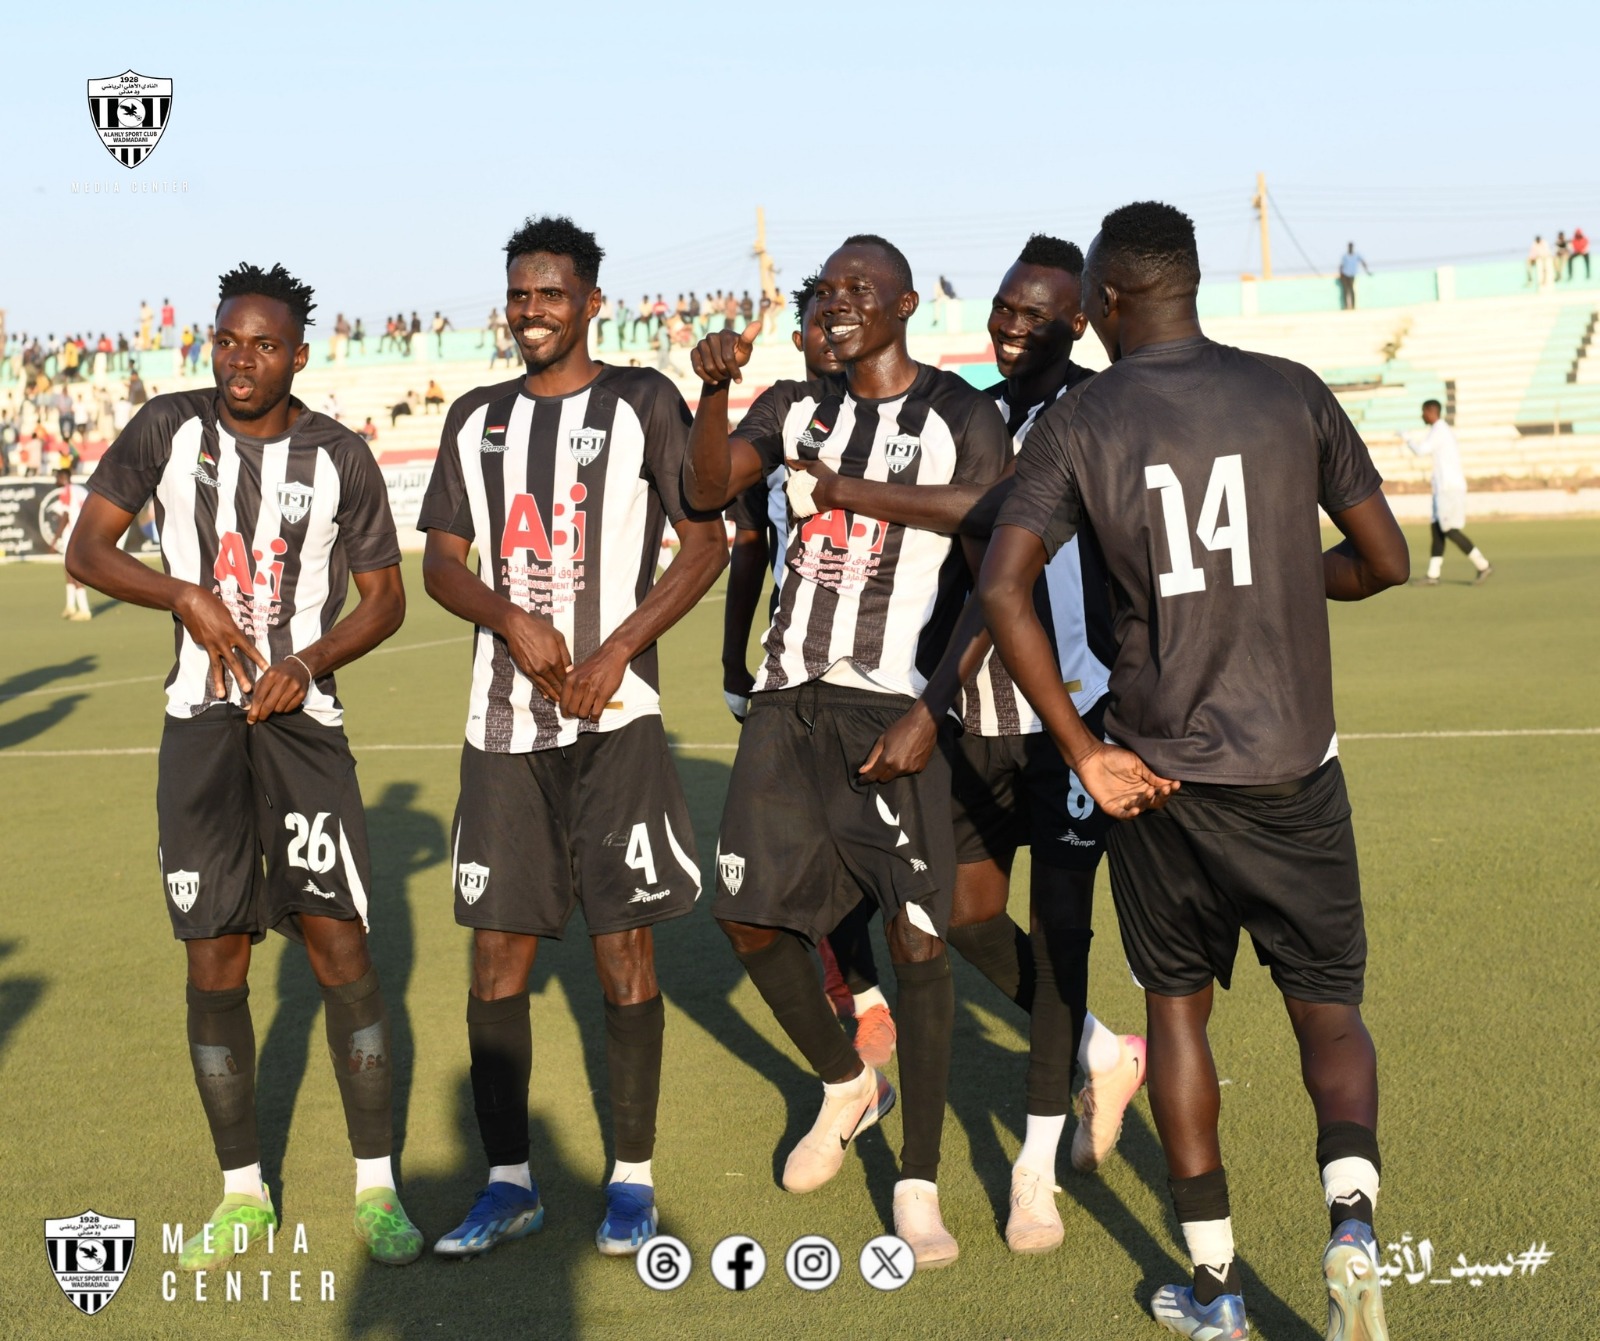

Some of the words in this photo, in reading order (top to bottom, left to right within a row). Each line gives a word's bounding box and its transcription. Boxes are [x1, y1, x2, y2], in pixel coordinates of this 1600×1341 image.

[1144, 453, 1253, 598] 14
[528, 579, 570, 590] INVESTMENT
[284, 812, 336, 874] 26
[624, 822, 658, 885] 4
[1070, 839, 1096, 848] tempo
[642, 889, 670, 903] tempo
